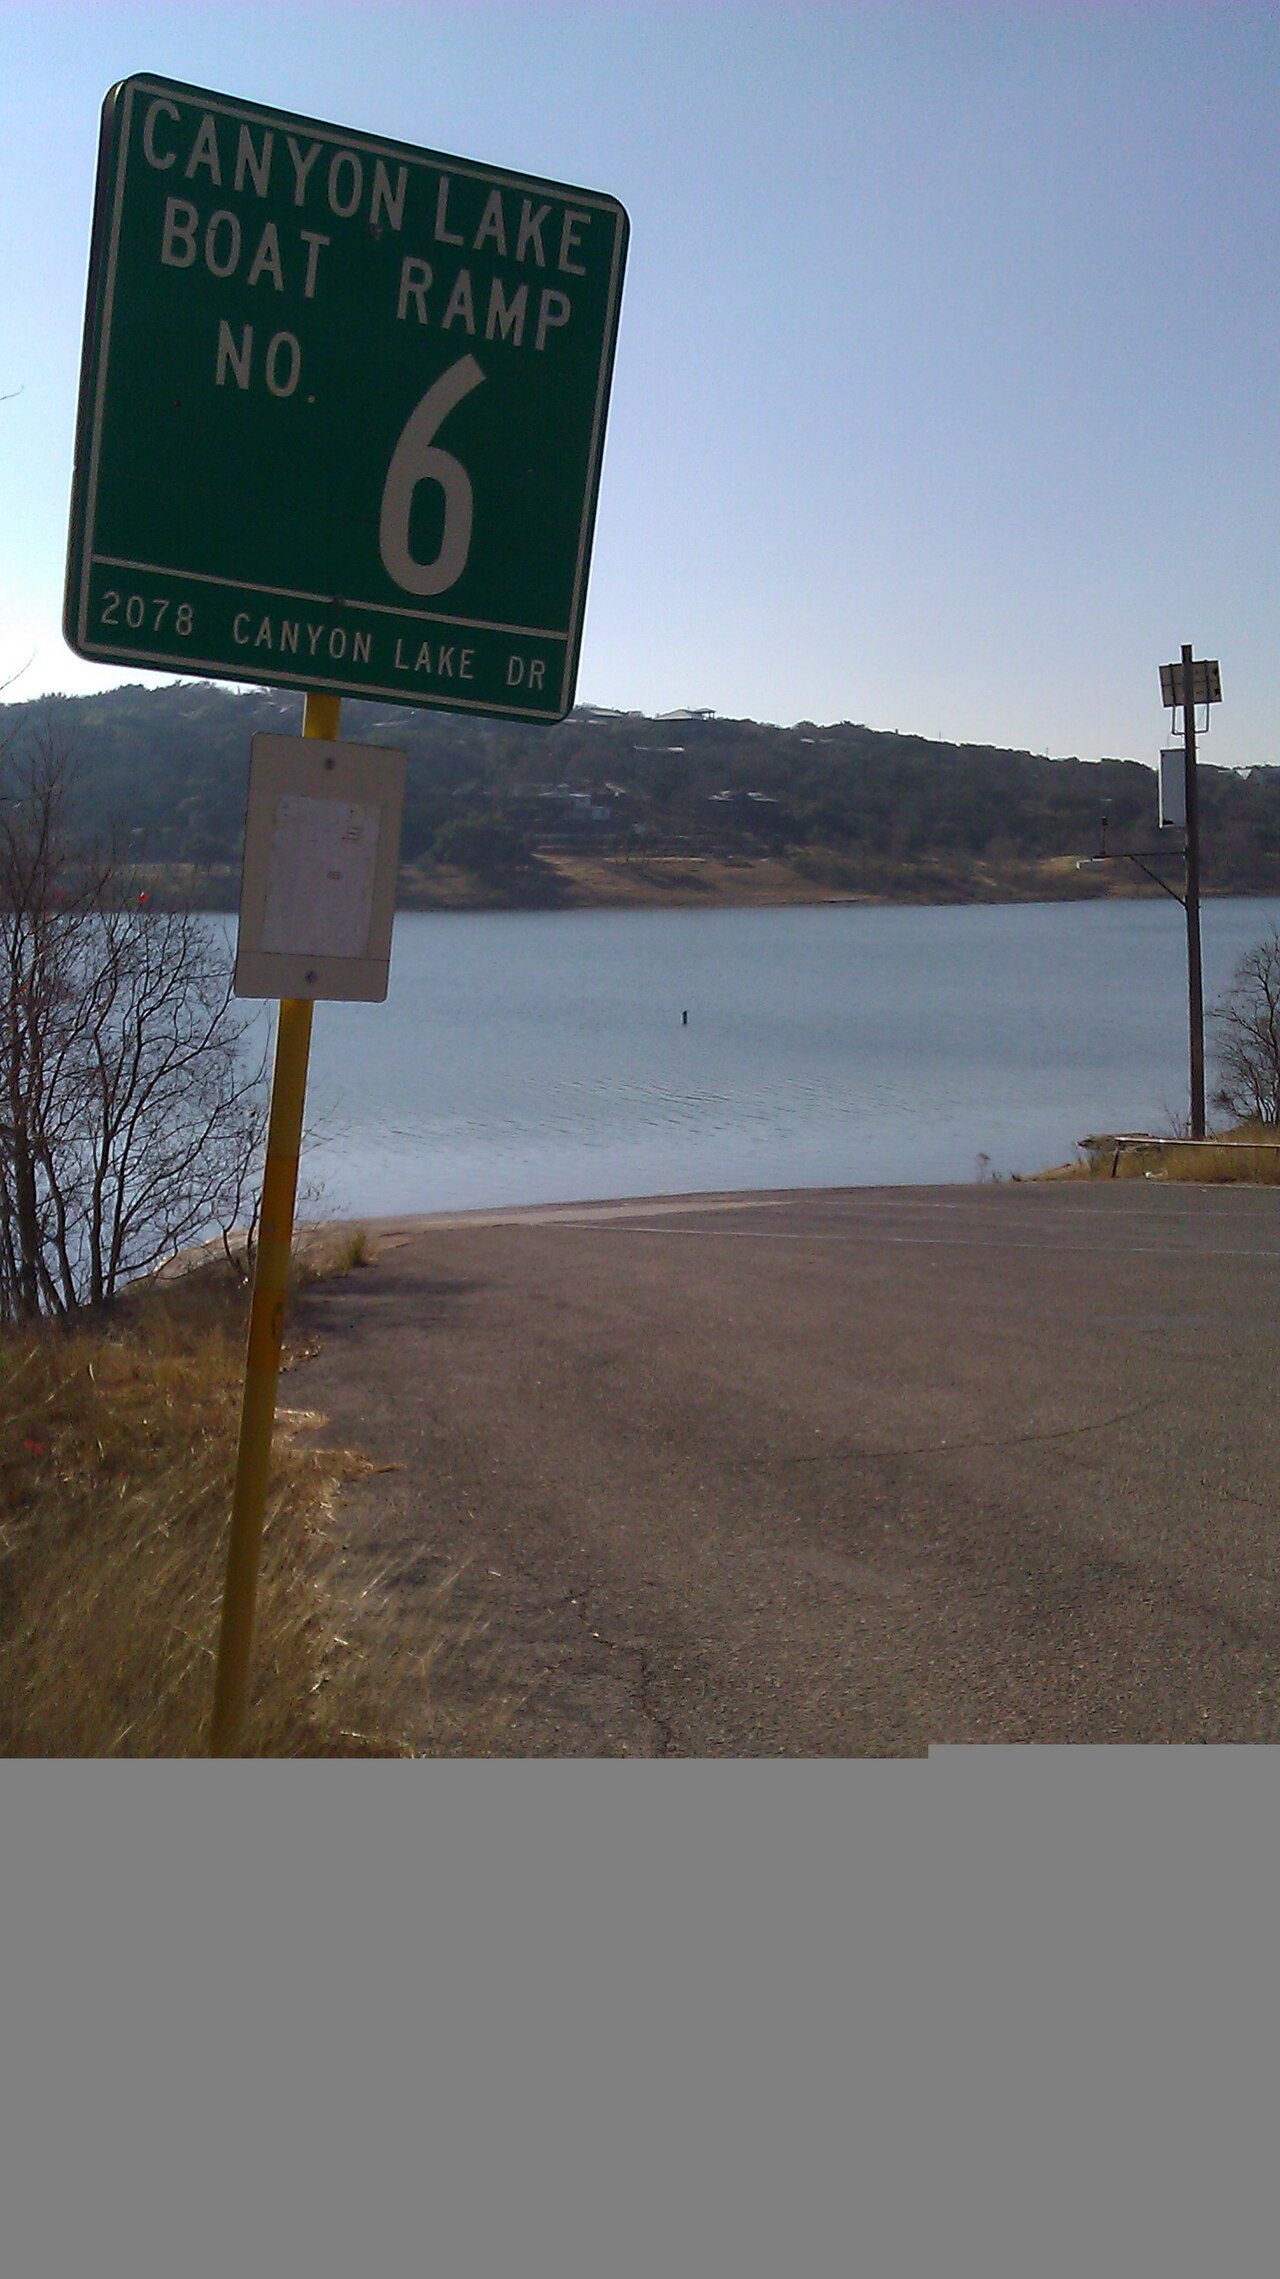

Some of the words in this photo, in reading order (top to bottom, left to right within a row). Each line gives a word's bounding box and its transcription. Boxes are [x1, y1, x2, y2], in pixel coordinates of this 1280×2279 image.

[142, 99, 408, 231] CANYON
[435, 176, 592, 276] LAKE
[160, 196, 330, 299] BOAT
[397, 256, 572, 351] RAMP
[215, 319, 315, 404] NO.
[379, 352, 486, 597] 6
[100, 591, 195, 637] 2078
[233, 612, 371, 664] CANYON
[394, 638, 475, 681] LAKE
[506, 655, 546, 691] DR
